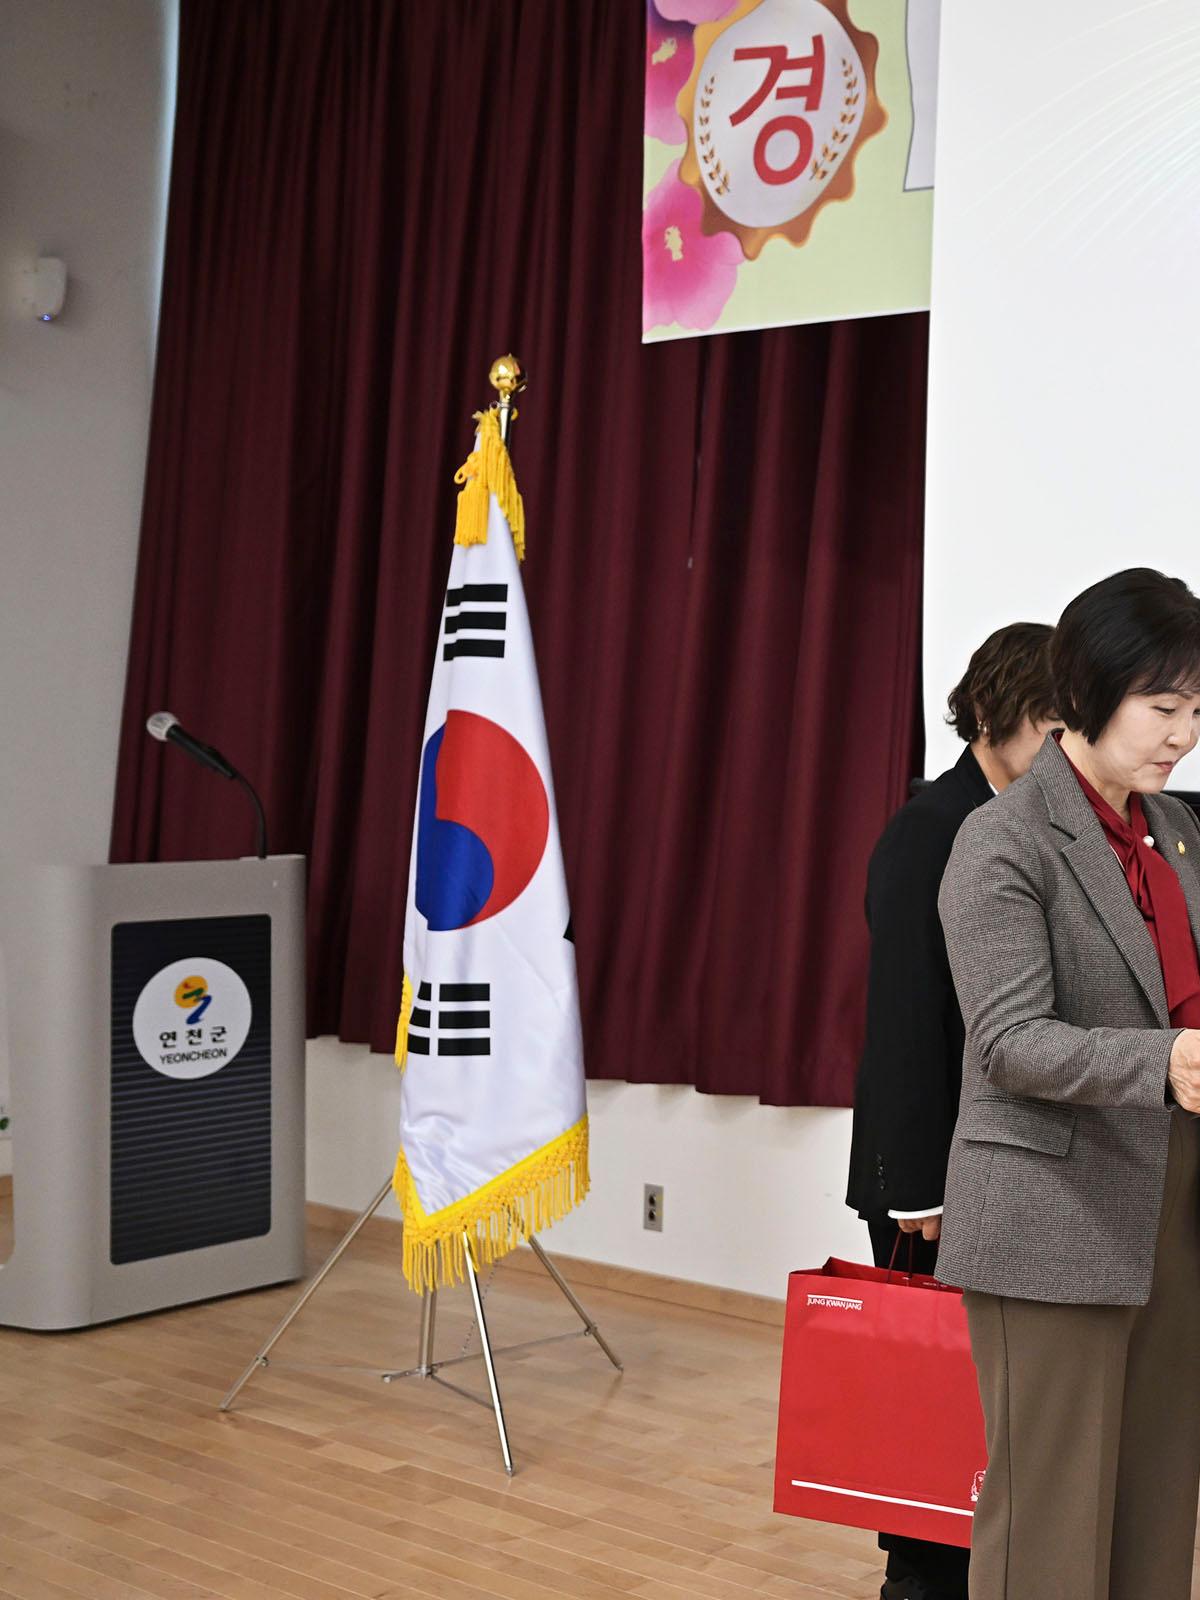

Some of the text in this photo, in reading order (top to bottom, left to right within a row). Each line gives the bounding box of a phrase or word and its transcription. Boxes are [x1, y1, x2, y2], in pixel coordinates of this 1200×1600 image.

[729, 33, 826, 187] 경
[160, 1047, 228, 1065] YEONCHEON
[806, 1297, 862, 1311] JUNG KWAN JANG
